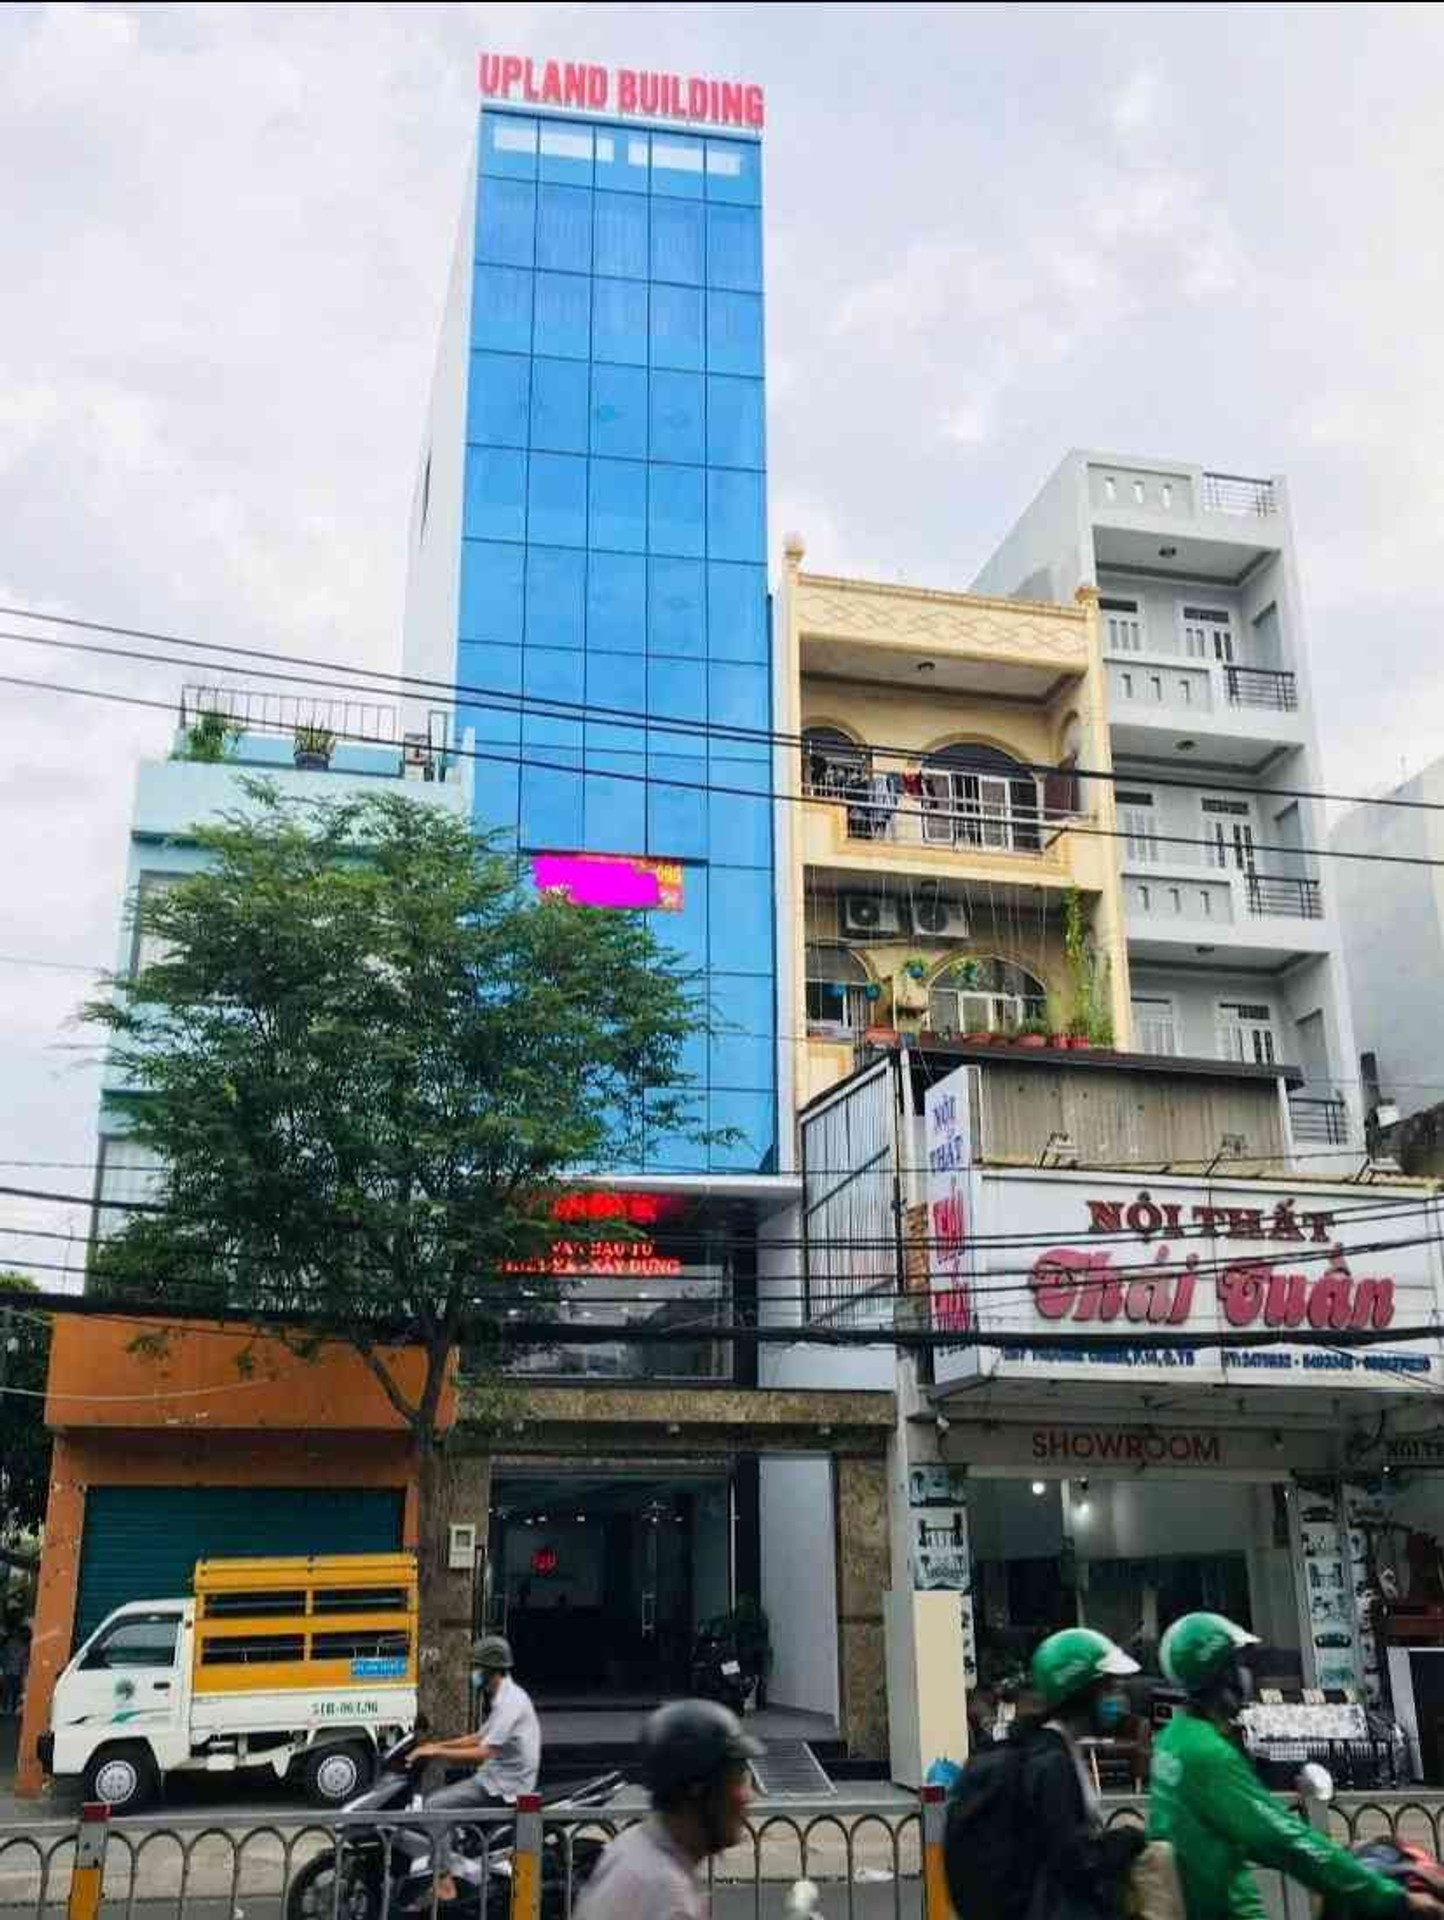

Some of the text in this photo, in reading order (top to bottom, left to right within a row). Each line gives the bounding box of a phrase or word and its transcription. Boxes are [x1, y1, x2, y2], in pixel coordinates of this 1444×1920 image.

[480, 53, 765, 128] UPLAND BUILDING
[1086, 1191, 1334, 1243] NỘI THẤT
[1029, 1244, 1200, 1326] Thái
[1032, 1430, 1221, 1462] SHOWROOM
